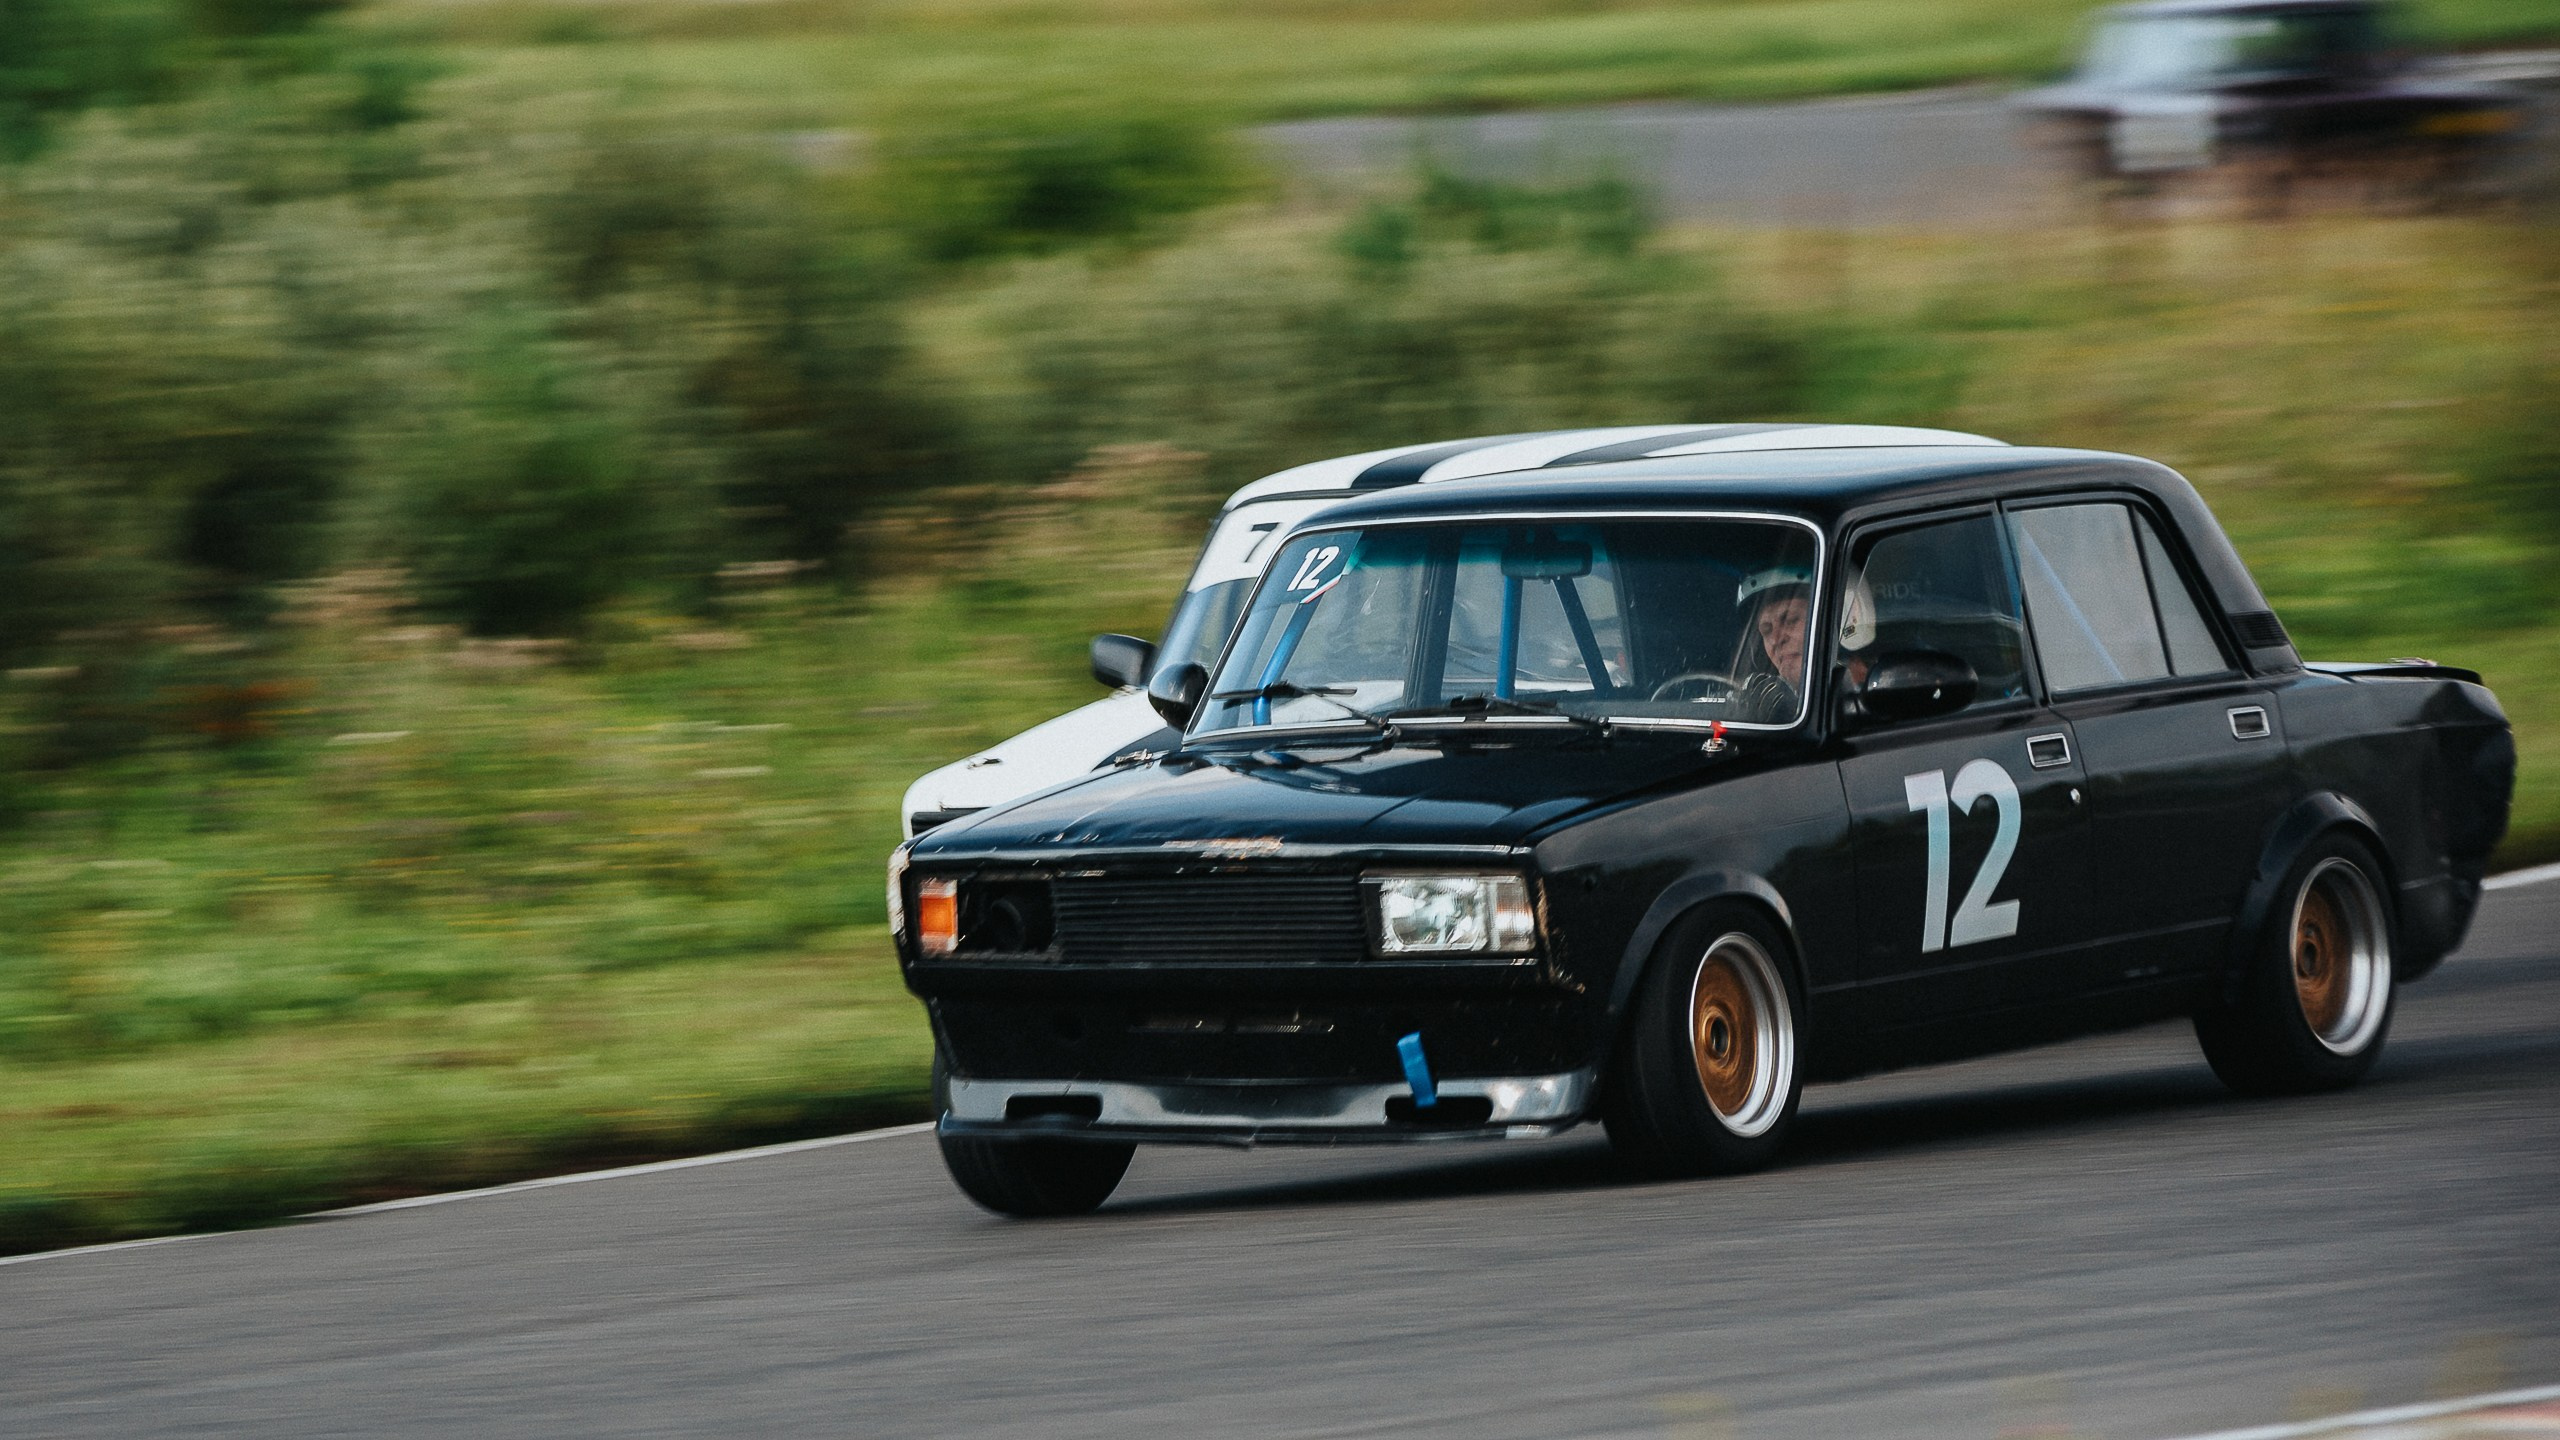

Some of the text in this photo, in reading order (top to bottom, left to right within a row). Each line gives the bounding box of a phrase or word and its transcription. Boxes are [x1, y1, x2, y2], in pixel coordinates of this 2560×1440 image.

[1243, 522, 1281, 563] 7
[1287, 546, 1340, 592] 12
[1904, 758, 2021, 953] 12
